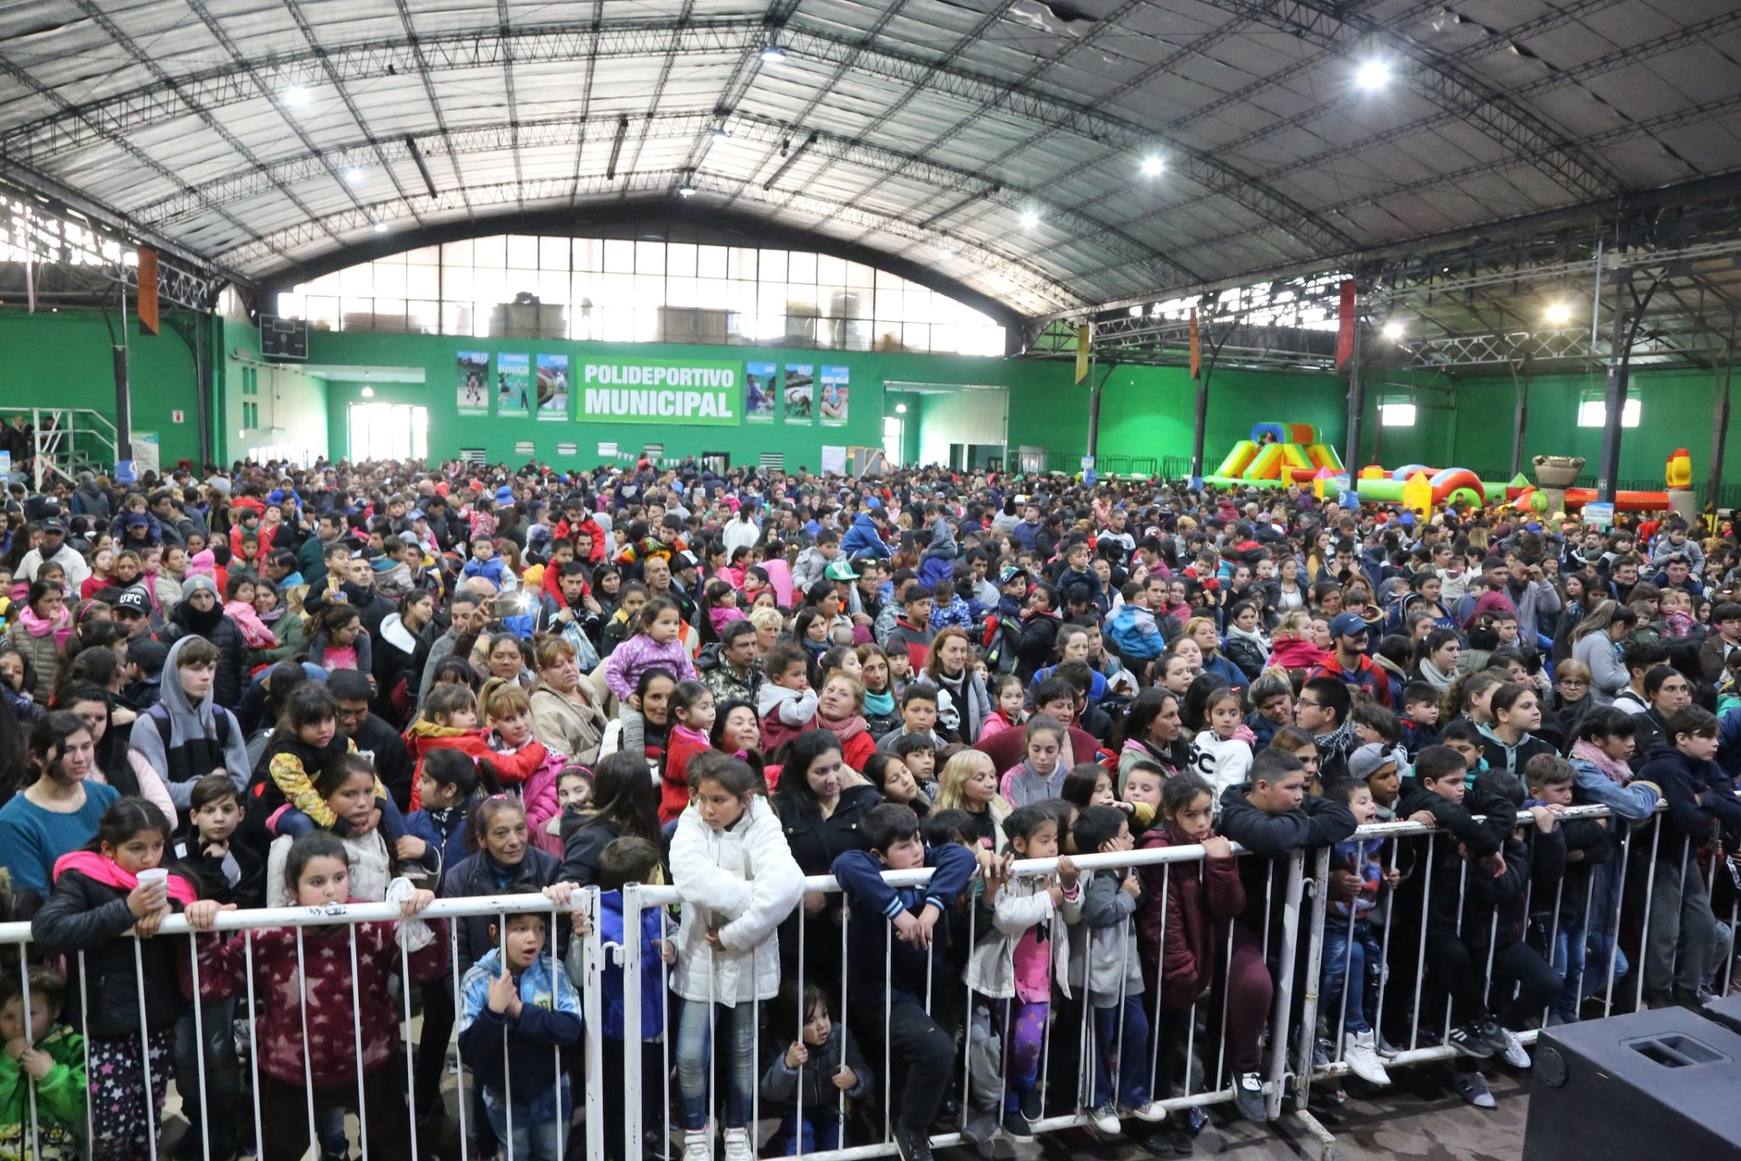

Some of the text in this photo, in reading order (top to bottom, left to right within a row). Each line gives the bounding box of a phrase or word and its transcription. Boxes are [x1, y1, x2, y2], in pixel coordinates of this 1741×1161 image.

[584, 364, 734, 388] POLIDEPORTIVO
[584, 388, 733, 417] MUNICIPAL
[120, 593, 141, 605] UFC
